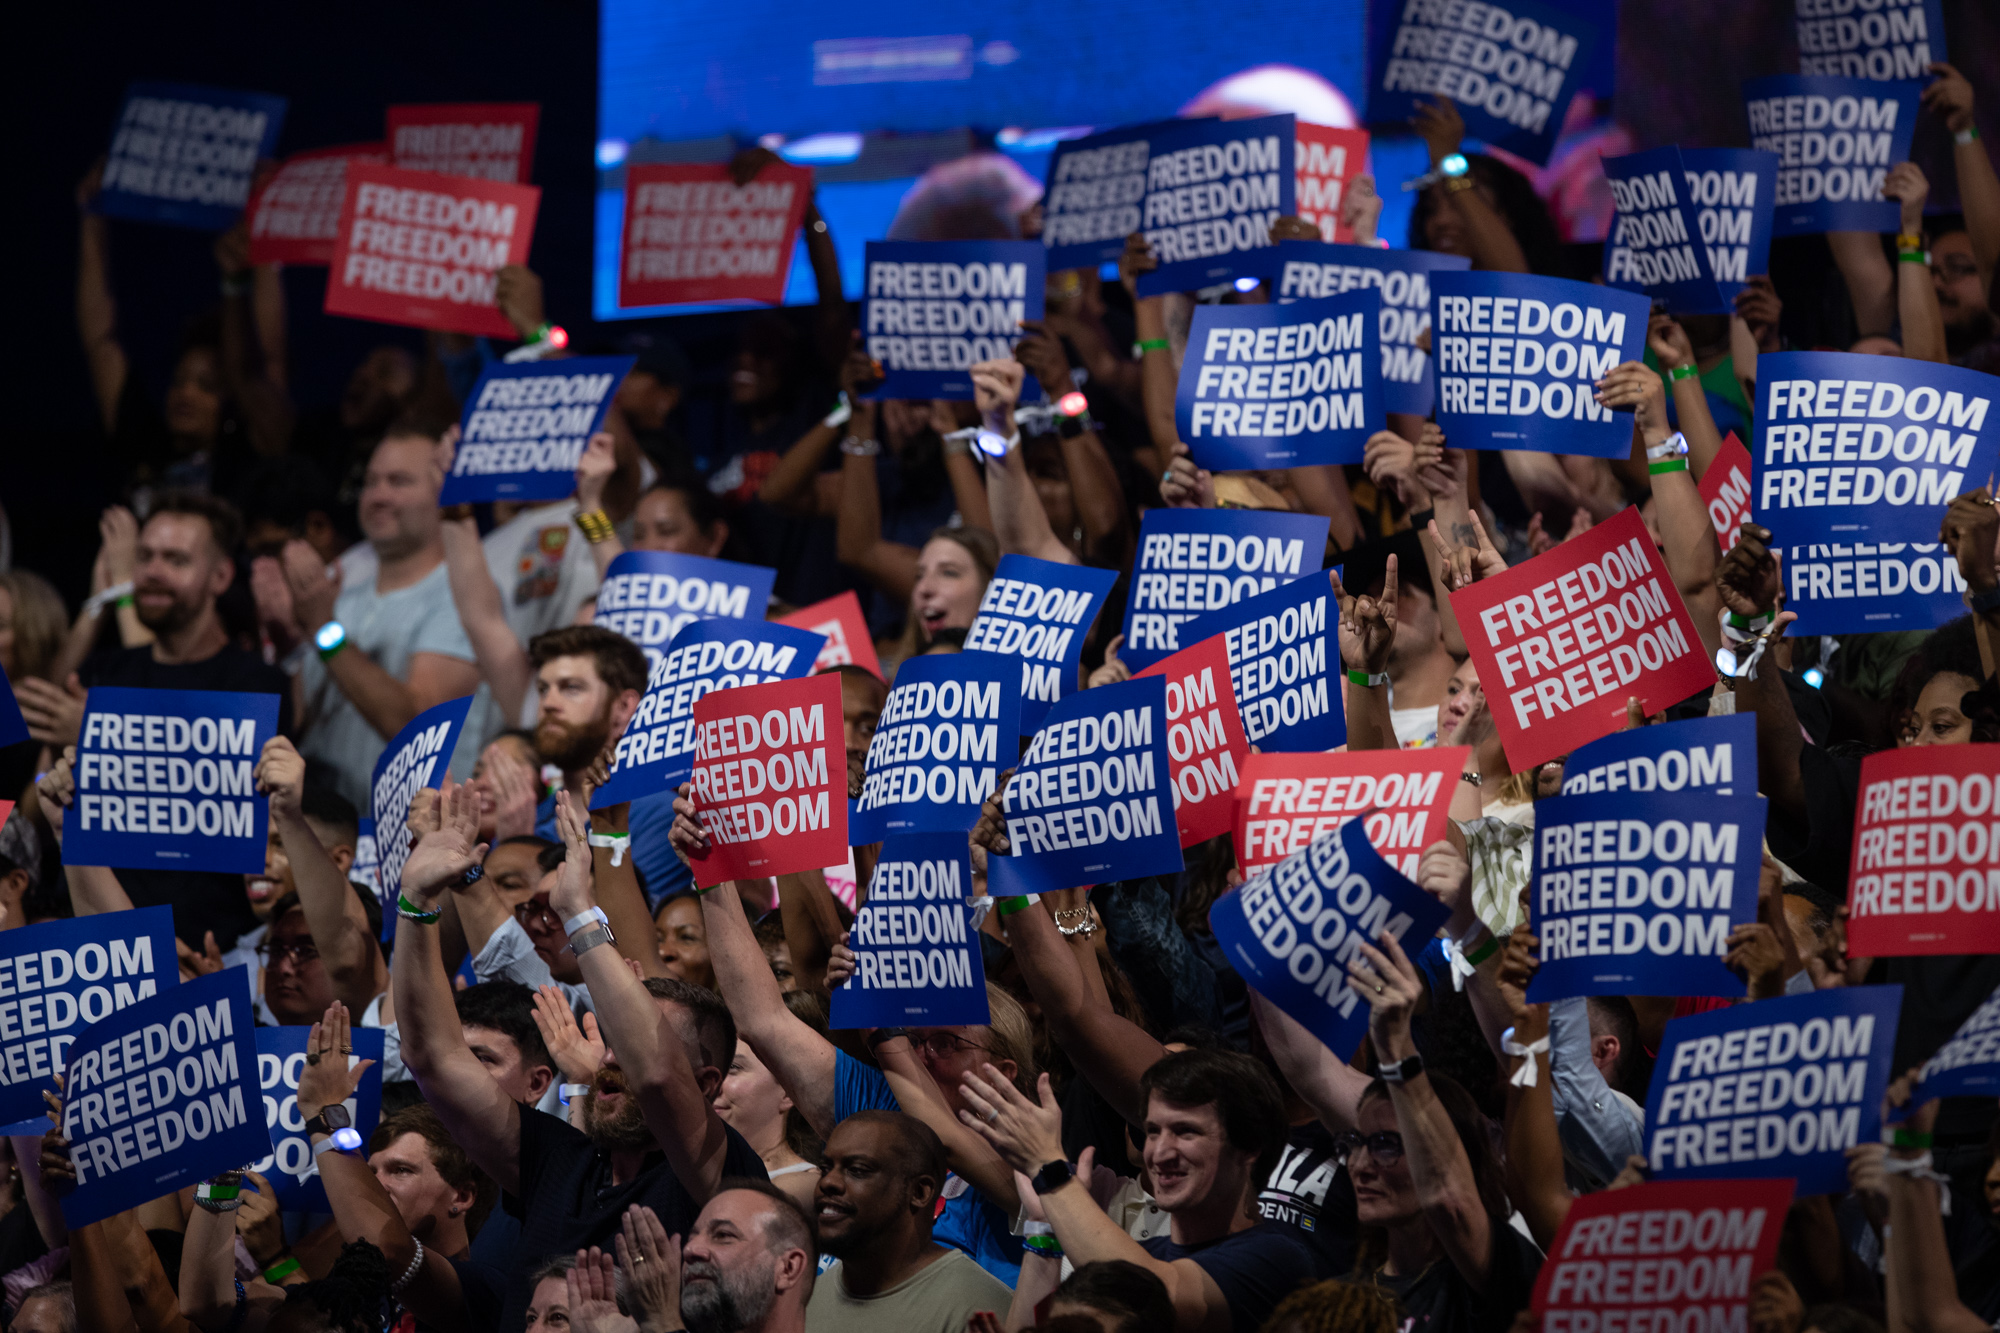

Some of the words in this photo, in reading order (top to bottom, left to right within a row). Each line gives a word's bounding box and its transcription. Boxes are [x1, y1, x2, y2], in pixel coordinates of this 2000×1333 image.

[1391, 23, 1566, 104] FREEDOM
[1382, 56, 1553, 137] FREEDOM
[1746, 94, 1900, 136] FREEDOM
[1148, 135, 1281, 192] FREEDOM
[356, 182, 518, 238] FREEDOM
[1143, 172, 1281, 230] FREEDOM
[350, 218, 509, 270] FREEDOM
[869, 261, 1028, 299] FREEDOM
[867, 298, 1026, 336] FREEDOM
[1203, 312, 1364, 362] FREEDOM
[1438, 295, 1627, 347] FREEDOM
[1195, 351, 1363, 400] FREEDOM
[1438, 336, 1621, 381] FREEDOM
[476, 372, 615, 410] FREEDOM
[1191, 391, 1365, 438] FREEDOM
[1767, 379, 1991, 432] FREEDOM
[463, 404, 600, 443] FREEDOM
[1763, 422, 1978, 468] FREEDOM
[452, 437, 587, 478] FREEDOM
[1760, 466, 1965, 511] FREEDOM
[1140, 532, 1304, 575] FREEDOM
[978, 577, 1094, 625] EEDOM
[1479, 537, 1653, 648] FREEDOM
[963, 616, 1075, 664] EEDOM
[1225, 595, 1327, 667] EEDOM
[1494, 577, 1672, 689] FREEDOM
[646, 638, 798, 694] REEDOM
[1509, 617, 1691, 730] FREEDOM
[83, 712, 257, 756] FREEDOM
[695, 703, 826, 763] REEDOM
[864, 721, 998, 772] FREEDOM
[1022, 705, 1153, 768] REEDOM
[80, 752, 254, 797] FREEDOM
[373, 720, 452, 823] FREEDOM
[855, 764, 997, 814] FREEDOM
[1002, 750, 1157, 814] FREEDOM
[1247, 771, 1444, 816] FREEDOM
[79, 793, 255, 839] FREEDOM
[1861, 772, 2000, 826] FREEDO
[1006, 795, 1163, 858] FREEDOM
[1540, 819, 1740, 869] FREEDOM
[1856, 820, 2000, 873] FREEDO
[1539, 865, 1735, 916] FREEDOM
[1539, 912, 1731, 963] FREEDOM
[0, 935, 155, 999] EEDOM
[66, 997, 234, 1100] FREEDOM
[1668, 1013, 1876, 1083] FREEDOM
[62, 1040, 241, 1143] FREEDOM
[1656, 1059, 1868, 1126] FREEDOM
[67, 1083, 248, 1187] FREEDOM
[1650, 1105, 1861, 1172] FREEDOM
[1560, 1206, 1768, 1260] FREEDOM
[1546, 1253, 1754, 1306] FREEDOM
